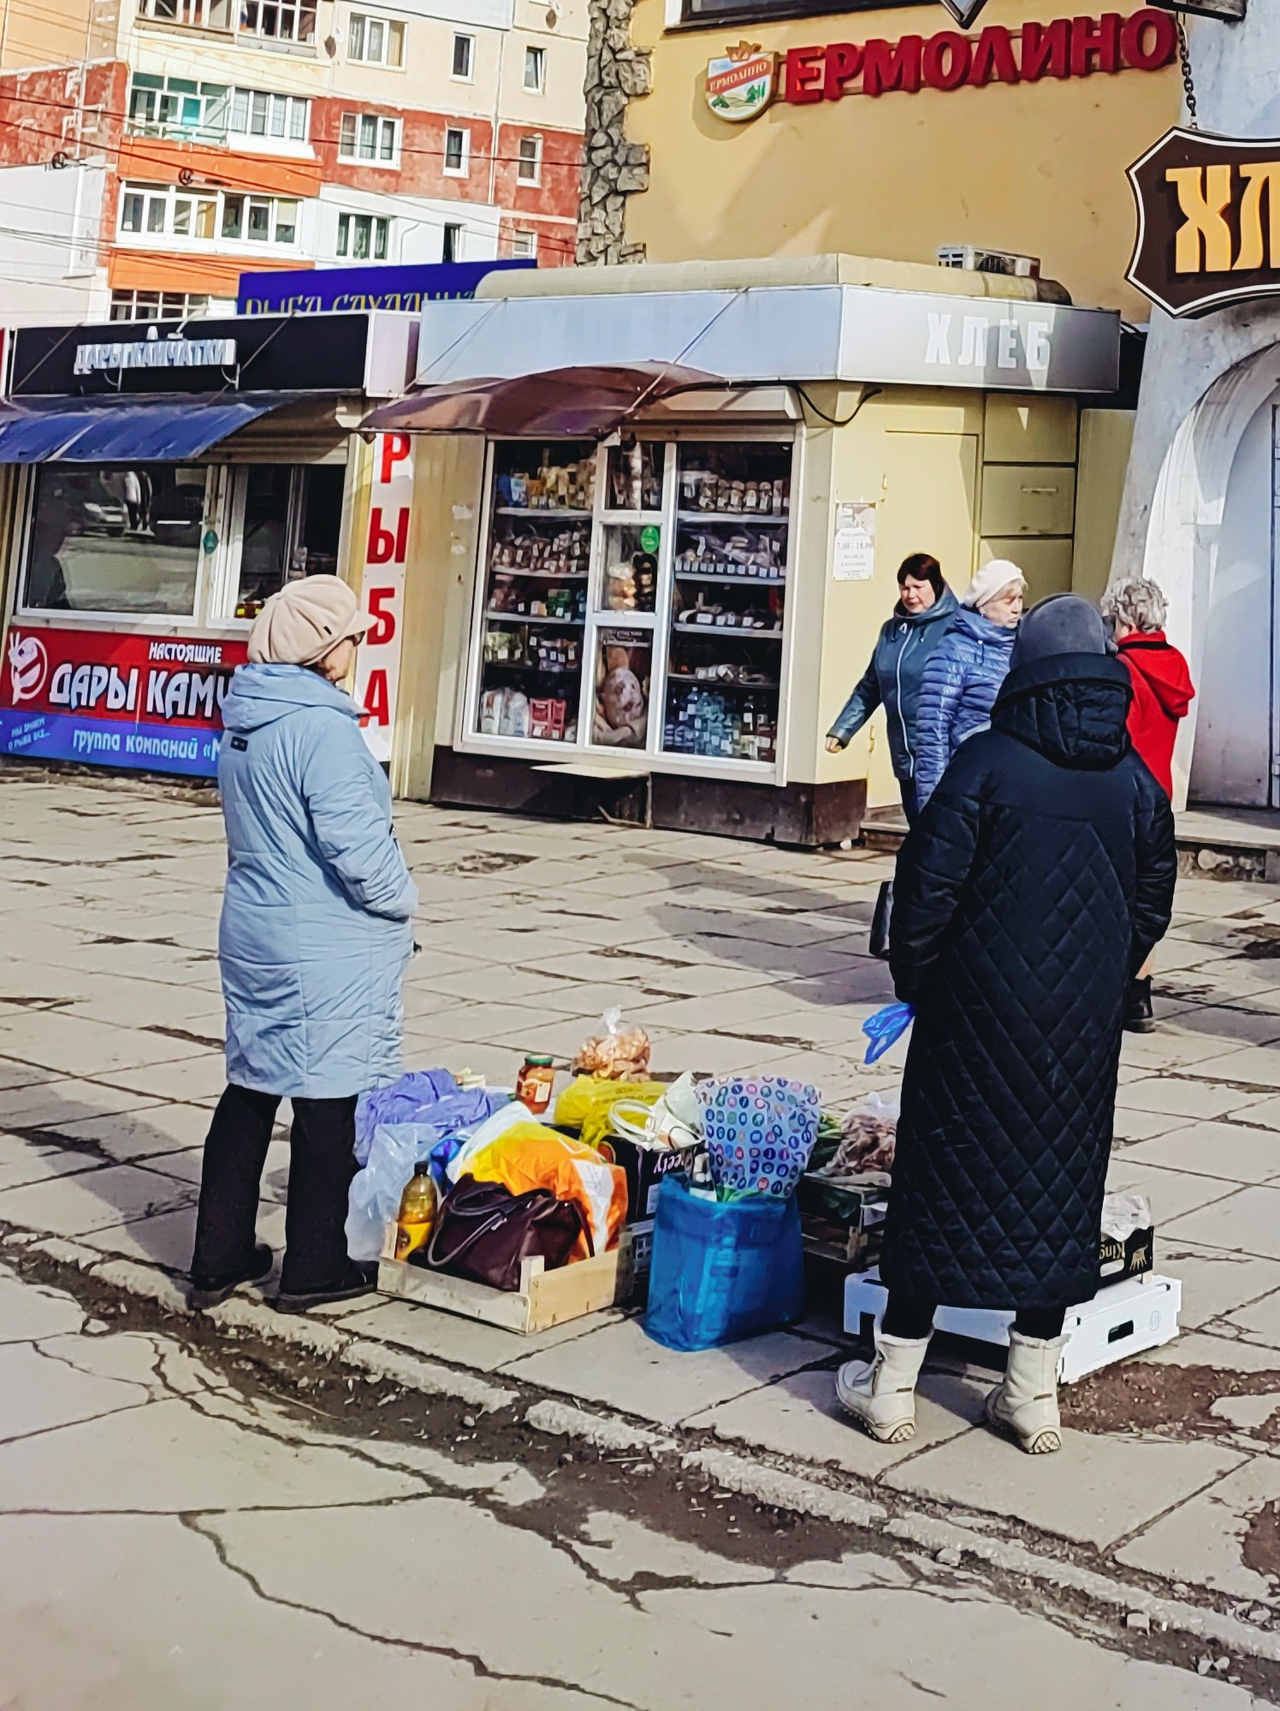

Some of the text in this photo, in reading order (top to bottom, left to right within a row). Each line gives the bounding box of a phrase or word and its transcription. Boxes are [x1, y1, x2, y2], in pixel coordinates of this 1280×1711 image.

[784, 8, 1178, 104] ЕРМОЛИНО
[924, 313, 1051, 370] ХЛЕБ
[359, 433, 411, 727] РЫБА
[50, 662, 139, 711] ДАРЫ
[73, 729, 120, 753] группа
[126, 734, 198, 760] компаний
